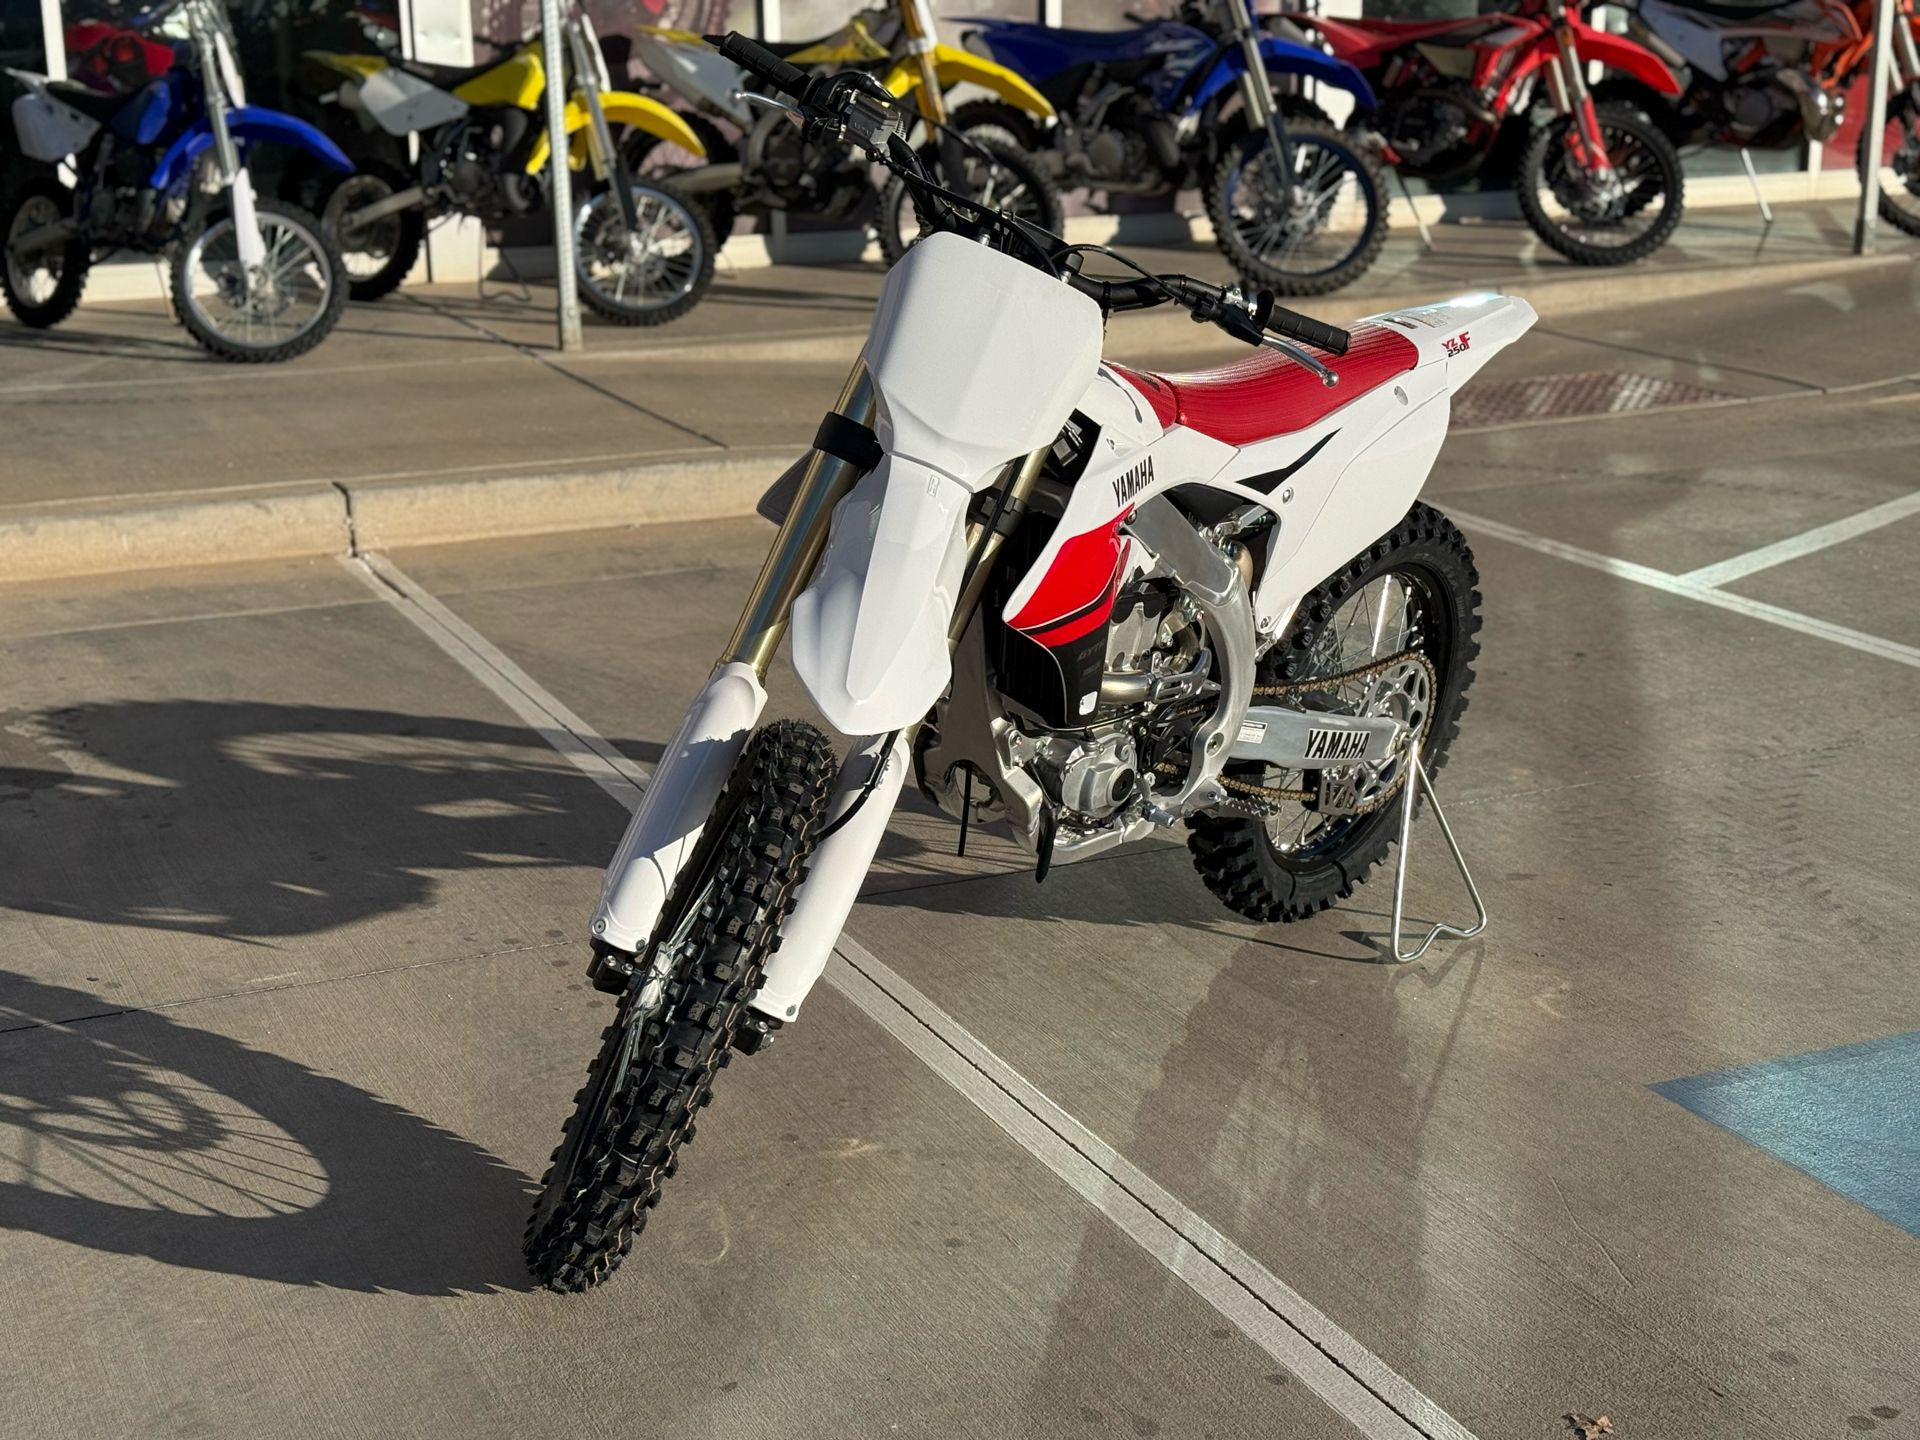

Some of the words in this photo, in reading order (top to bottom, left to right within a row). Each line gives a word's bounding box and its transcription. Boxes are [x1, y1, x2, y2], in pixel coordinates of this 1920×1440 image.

[1441, 338, 1458, 349] YZ
[1112, 455, 1154, 507] YAMAHA
[1304, 729, 1371, 759] YAMAHA
